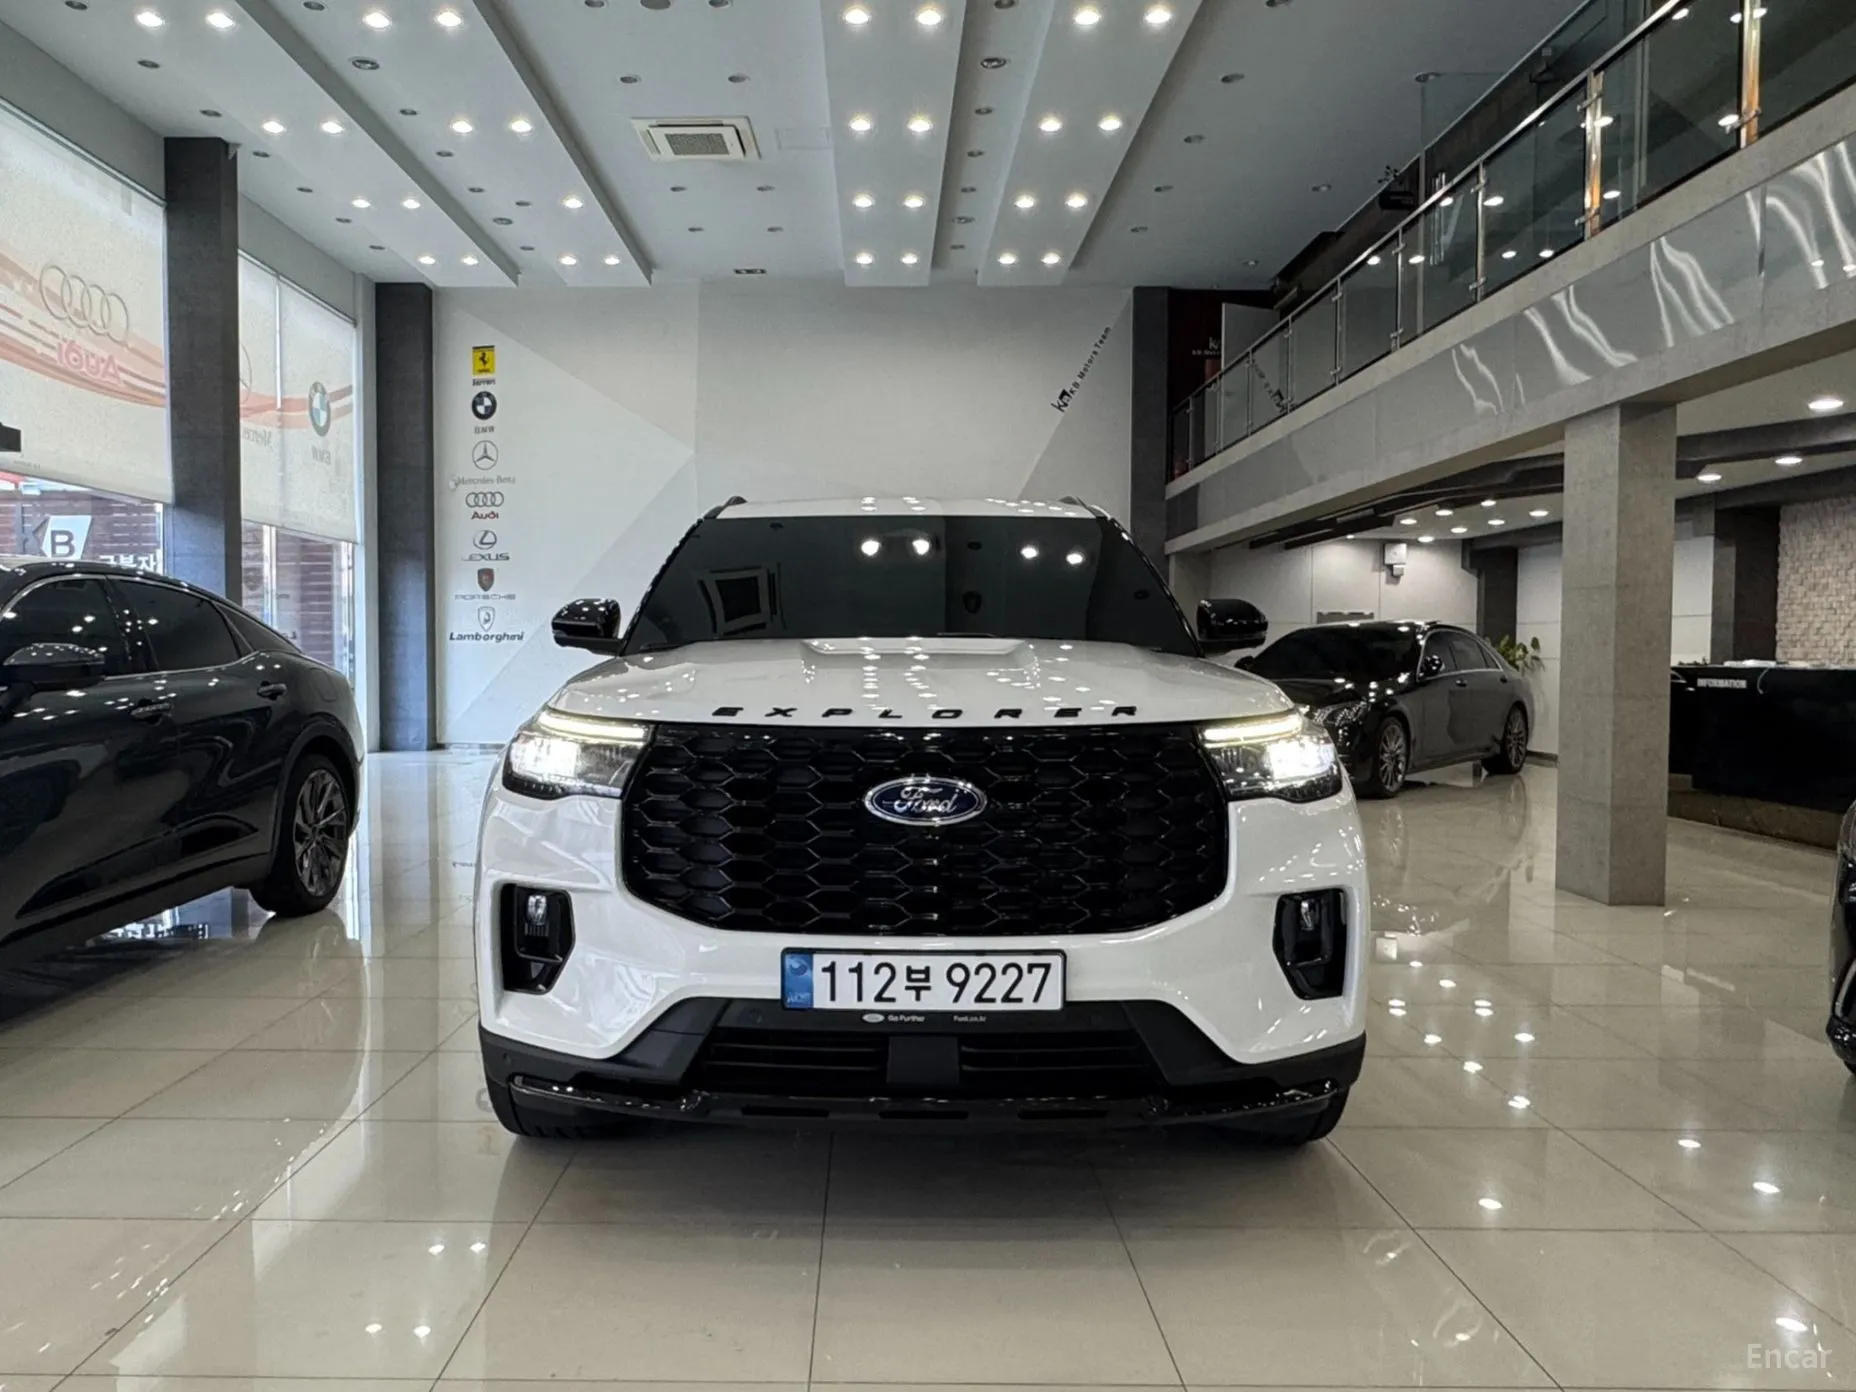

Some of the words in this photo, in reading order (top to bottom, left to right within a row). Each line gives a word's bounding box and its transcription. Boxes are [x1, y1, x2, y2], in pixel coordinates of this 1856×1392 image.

[471, 511, 499, 520] Audi
[461, 552, 510, 561] LEXUS
[449, 632, 524, 643] Lamborghini
[1697, 678, 1747, 689] INFORMATION
[711, 705, 1138, 720] EXPLORER
[882, 786, 959, 813] Ford
[821, 961, 932, 1003] 112부
[946, 962, 1052, 1004] 9227
